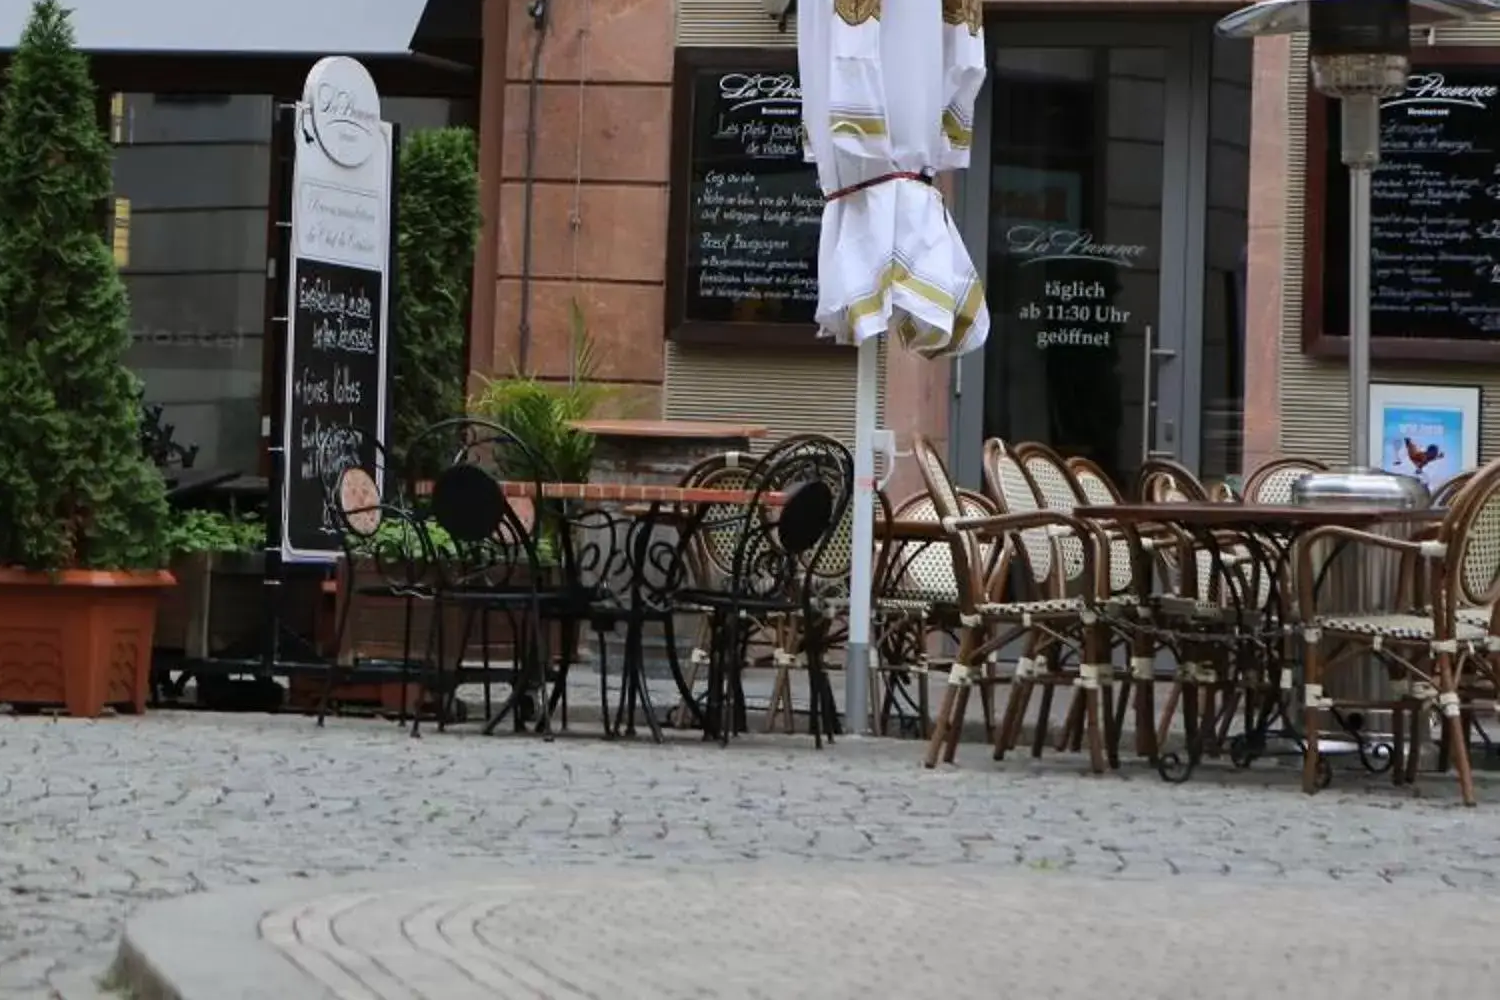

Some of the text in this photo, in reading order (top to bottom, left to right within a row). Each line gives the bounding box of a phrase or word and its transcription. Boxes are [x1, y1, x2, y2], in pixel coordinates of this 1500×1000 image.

[1406, 72, 1498, 101] Provence
[1051, 229, 1148, 259] Provence
[1045, 281, 1106, 301] täglich
[1018, 303, 1131, 323] ab 11:30 Uhr
[1036, 327, 1110, 348] geöffnet
